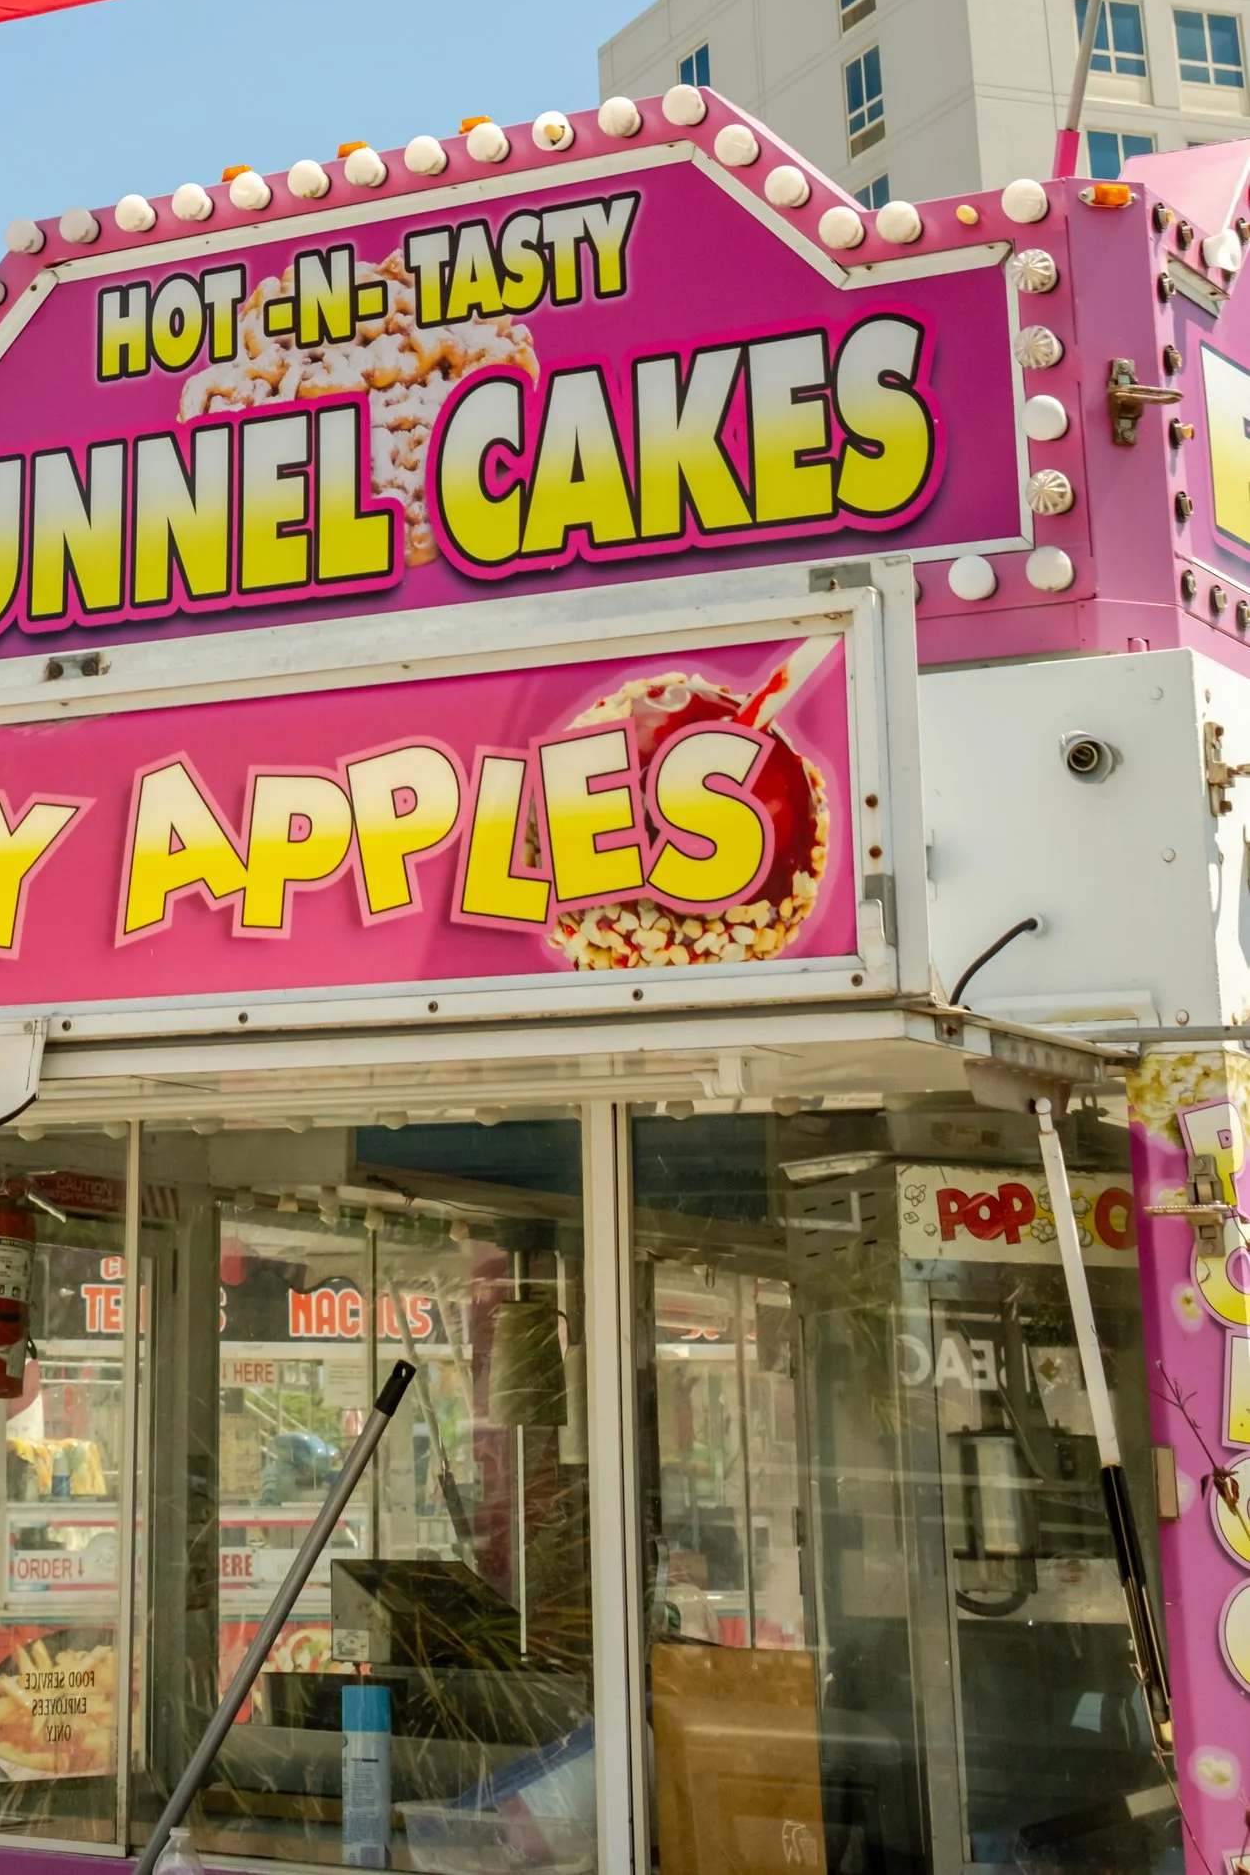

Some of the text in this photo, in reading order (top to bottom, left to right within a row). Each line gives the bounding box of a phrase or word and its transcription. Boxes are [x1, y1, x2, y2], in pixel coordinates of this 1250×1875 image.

[97, 263, 247, 382] HOT
[405, 190, 641, 328] TASTY
[436, 312, 935, 567] CAKES
[124, 727, 768, 934] APPLES
[56, 1176, 113, 1196] CAUTION
[936, 1182, 1035, 1245] POP
[233, 1362, 275, 1384] HERE
[17, 1557, 73, 1580] ORDER
[220, 1553, 253, 1578] ERE
